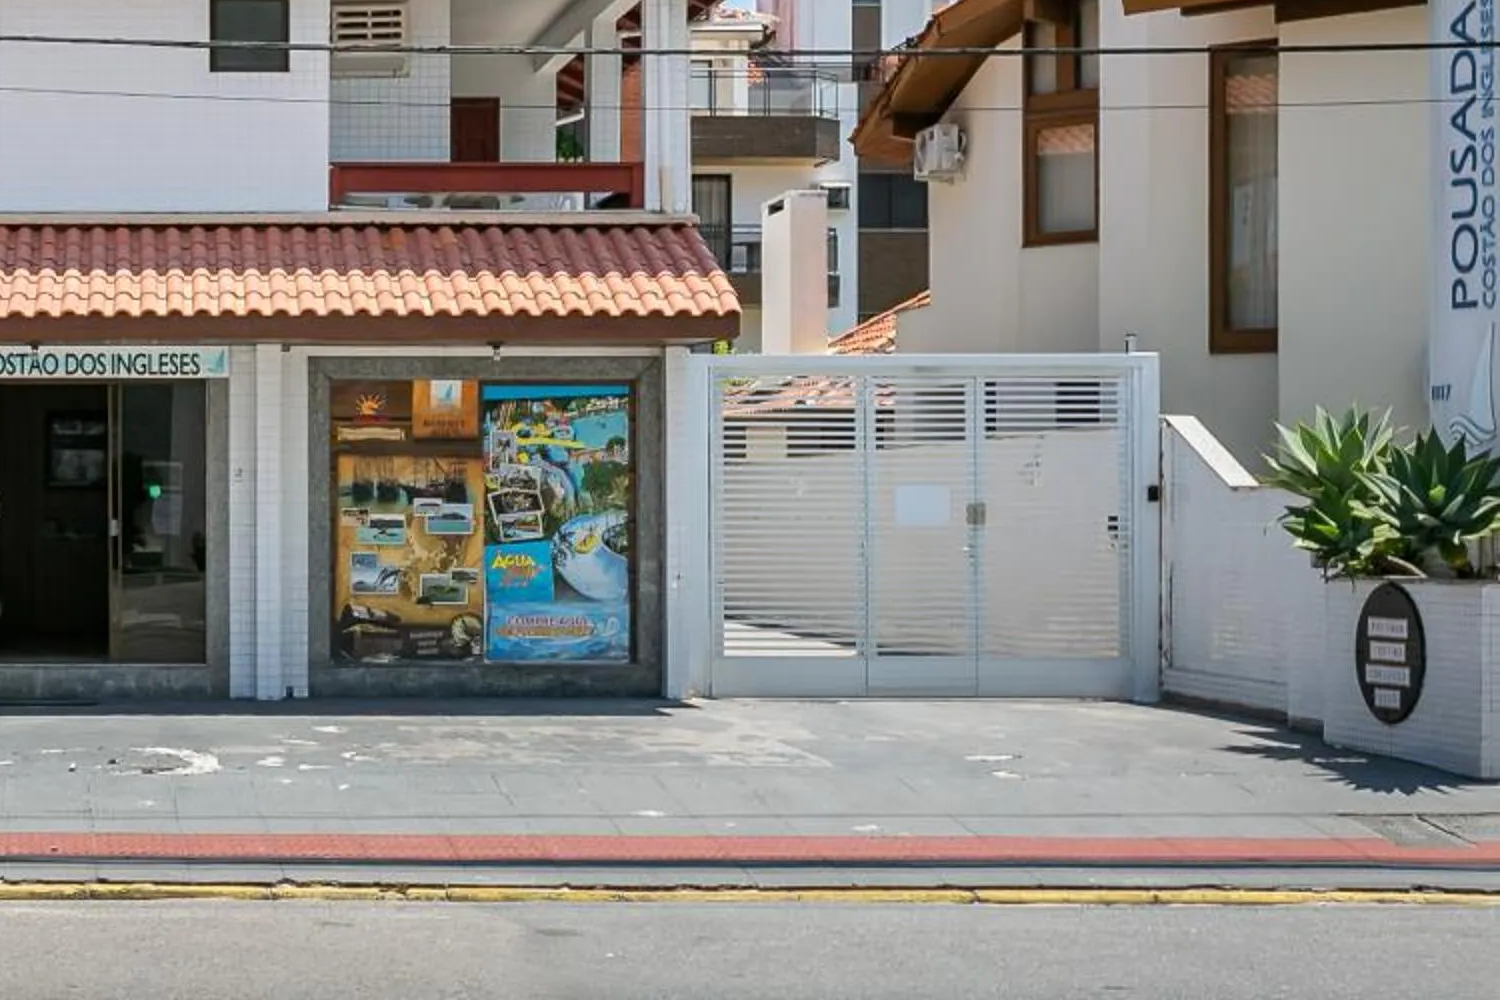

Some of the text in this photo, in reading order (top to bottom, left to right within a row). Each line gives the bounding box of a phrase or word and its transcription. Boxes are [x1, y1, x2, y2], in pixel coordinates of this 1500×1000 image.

[1450, 0, 1479, 310] POUSADA
[1480, 127, 1495, 187] DOS
[1480, 194, 1496, 309] COSTÃO
[65, 352, 107, 375] DOS
[112, 352, 201, 375] INGLESES
